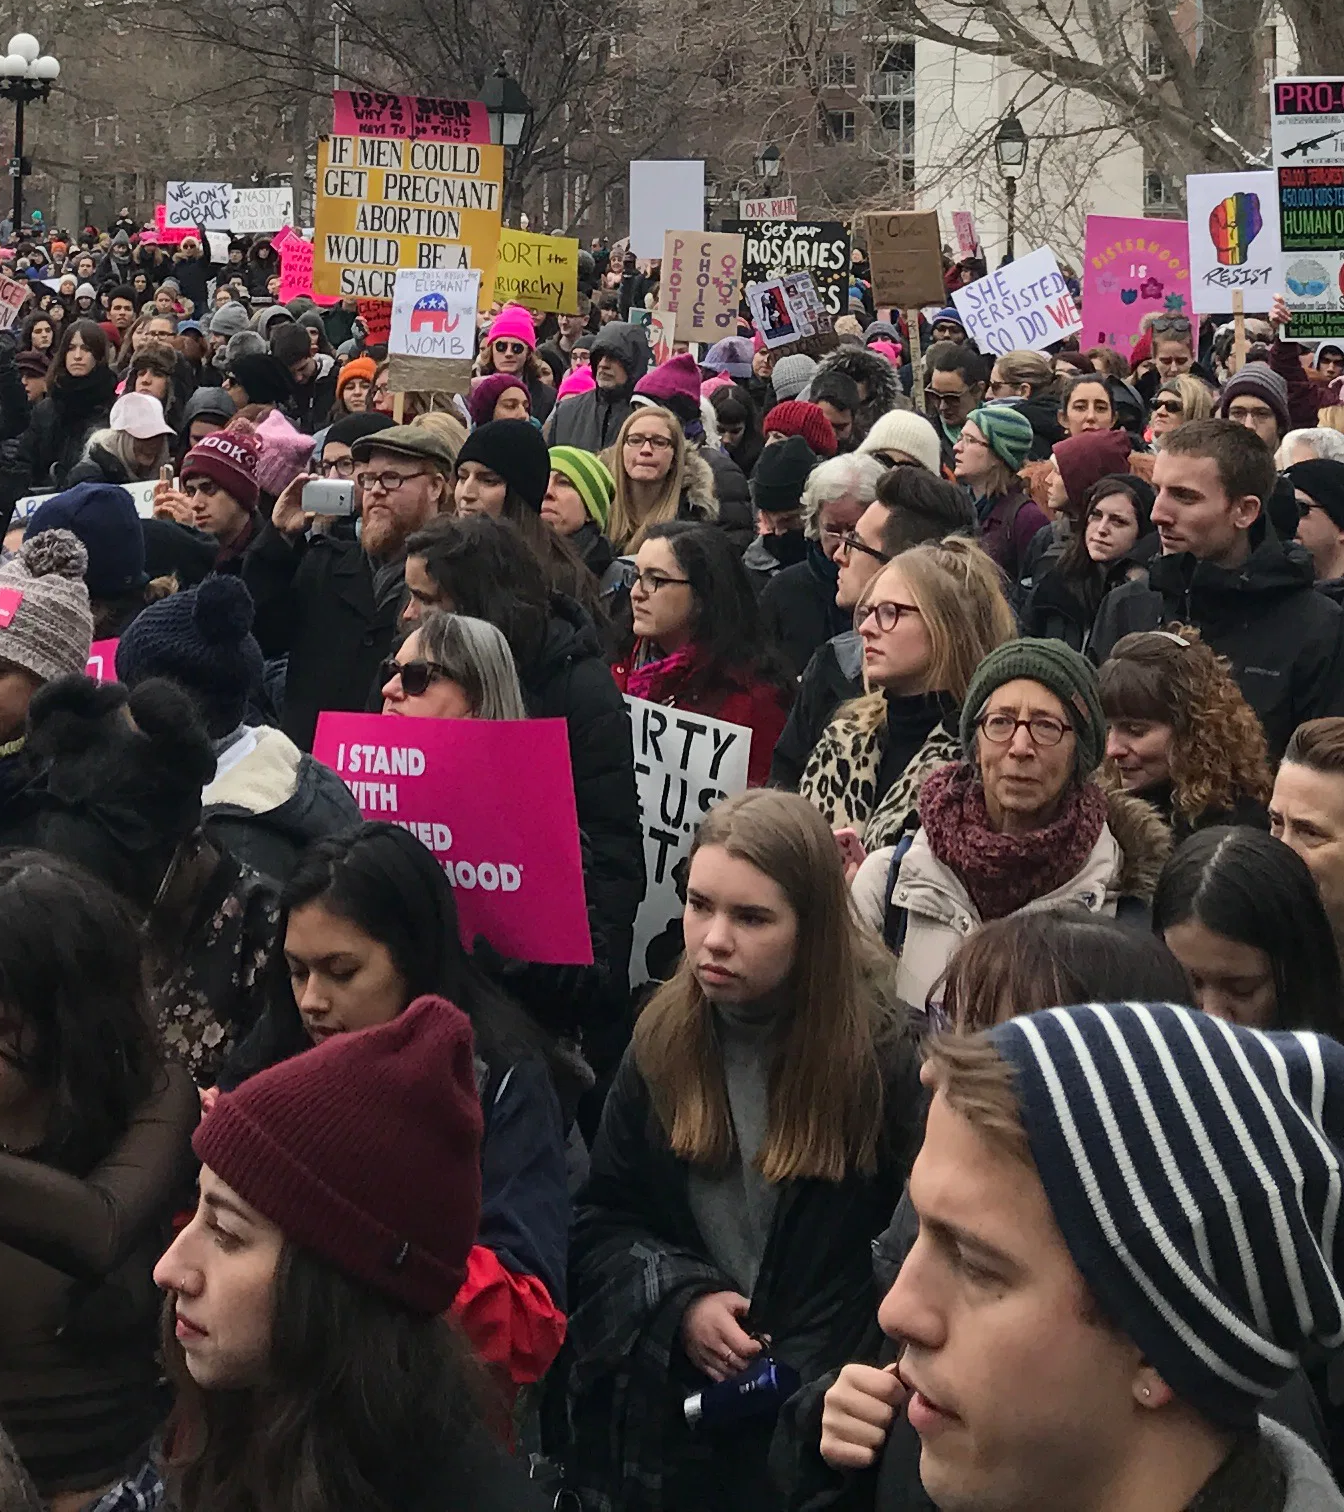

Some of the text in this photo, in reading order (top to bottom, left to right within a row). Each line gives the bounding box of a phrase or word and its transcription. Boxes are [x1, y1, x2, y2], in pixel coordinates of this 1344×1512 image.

[349, 91, 471, 118] 1992 SIGN
[390, 124, 406, 135] TO
[359, 139, 404, 168] MEN
[411, 143, 480, 174] COULD
[168, 181, 193, 202] WE
[182, 184, 228, 208] WON'T
[243, 190, 283, 203] NASTY
[324, 169, 498, 210] GET PREGNANT
[169, 207, 191, 224] GO
[190, 199, 231, 225] BACK
[356, 205, 461, 238] ABORTION
[745, 202, 771, 218] OUR
[1284, 210, 1332, 234] HUMAN
[761, 222, 822, 239] Get your
[327, 235, 399, 266] WOULD
[418, 242, 446, 270] BE
[457, 247, 471, 270] A
[548, 254, 568, 265] the
[746, 238, 846, 270] ROSARIES
[1091, 238, 1189, 280] SISTERHOOD
[1130, 264, 1147, 279] IS
[1202, 267, 1273, 288] RESIST
[415, 278, 470, 293] ELEPHANT
[692, 242, 712, 328] CHOICE
[965, 271, 1010, 310] SHE
[965, 271, 1065, 338] PERSISTED
[986, 293, 1082, 356] SO DO WE
[1291, 313, 1325, 325] E-FUND
[405, 334, 465, 355] WOMB
[624, 703, 738, 781] RTY
[337, 743, 426, 776] I STAND
